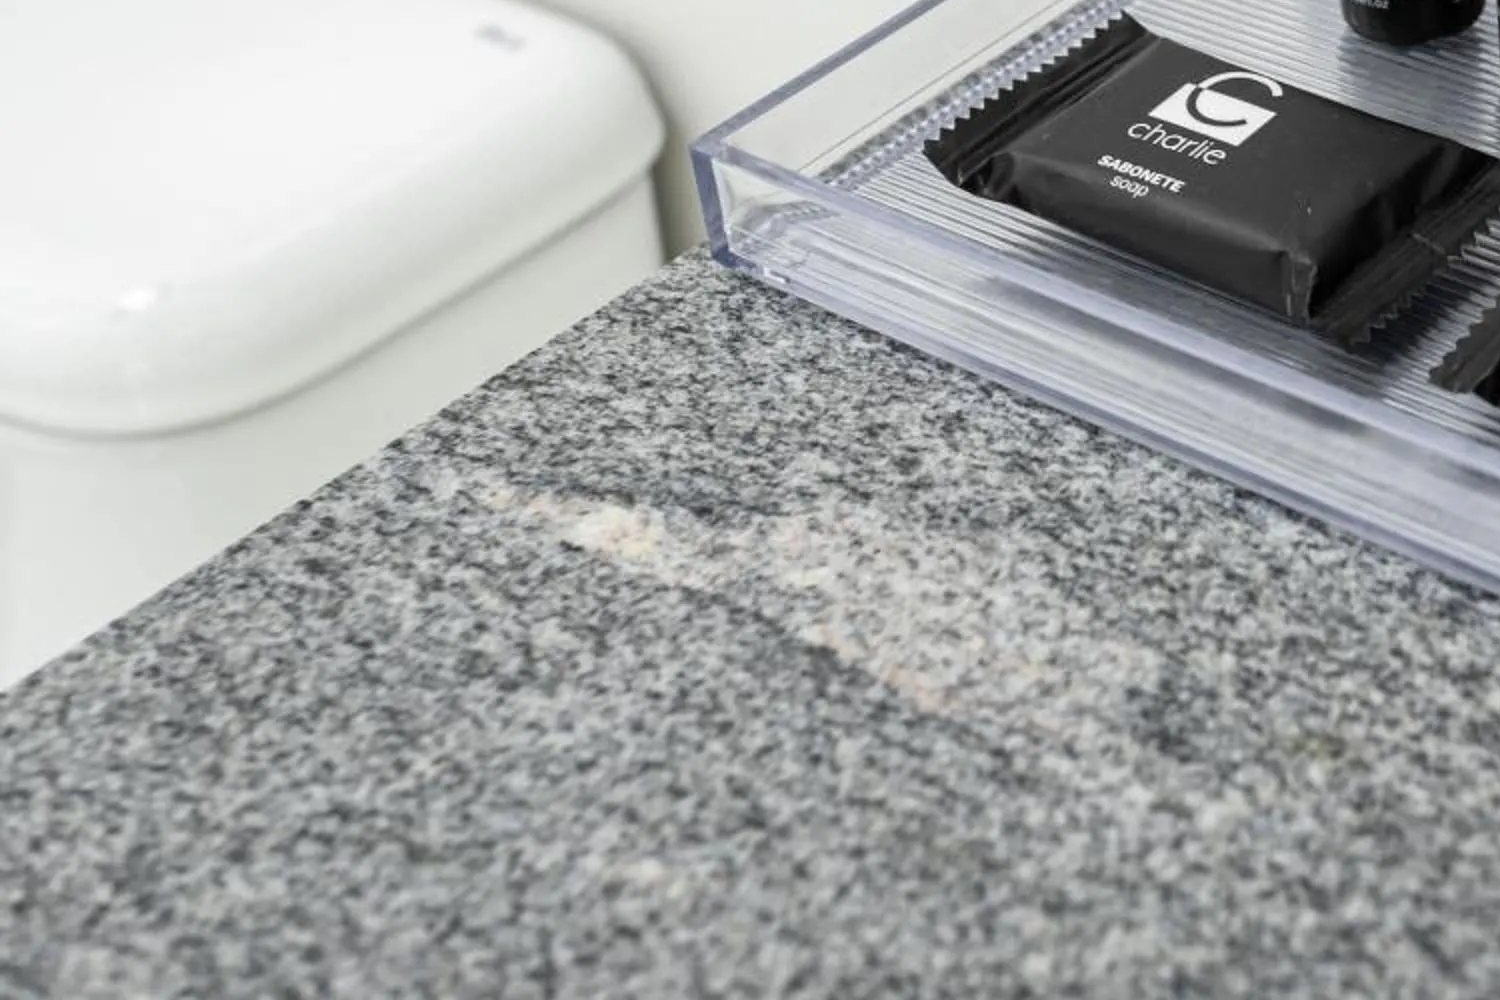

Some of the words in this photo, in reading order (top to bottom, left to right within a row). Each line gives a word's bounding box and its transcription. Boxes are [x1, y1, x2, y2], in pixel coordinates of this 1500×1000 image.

[1127, 122, 1227, 165] charlie
[1097, 154, 1186, 193] SABONETE
[1109, 175, 1149, 198] soap
